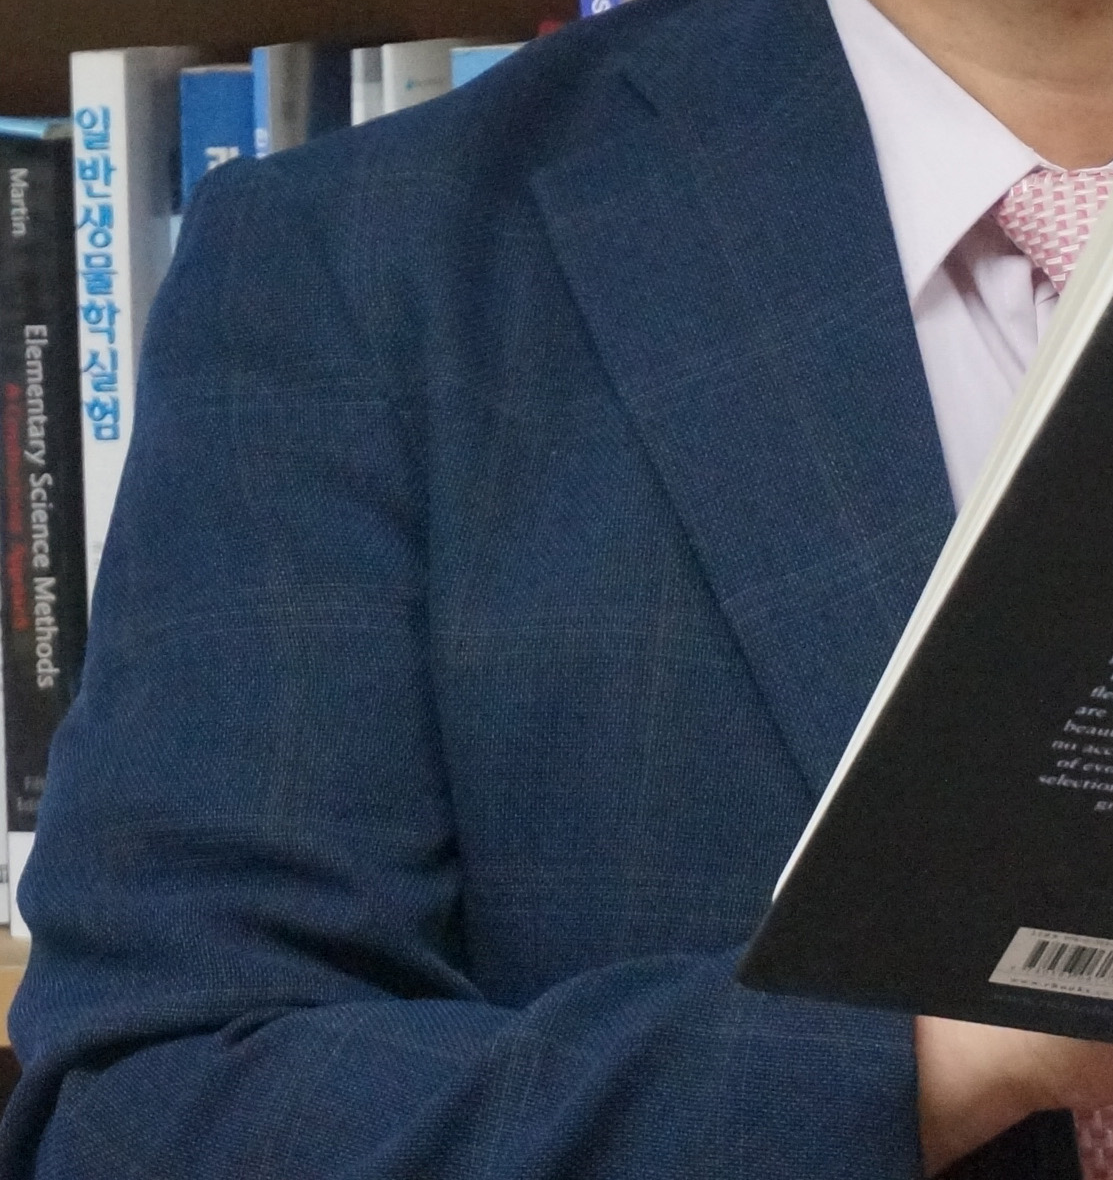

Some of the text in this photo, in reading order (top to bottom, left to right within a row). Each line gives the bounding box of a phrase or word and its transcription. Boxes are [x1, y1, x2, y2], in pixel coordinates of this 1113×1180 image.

[8, 166, 29, 238] Martin
[23, 323, 60, 689] Elementary Science Methods
[1075, 706, 1107, 717] are
[1052, 740, 1077, 750] no
[1057, 758, 1082, 768] of
